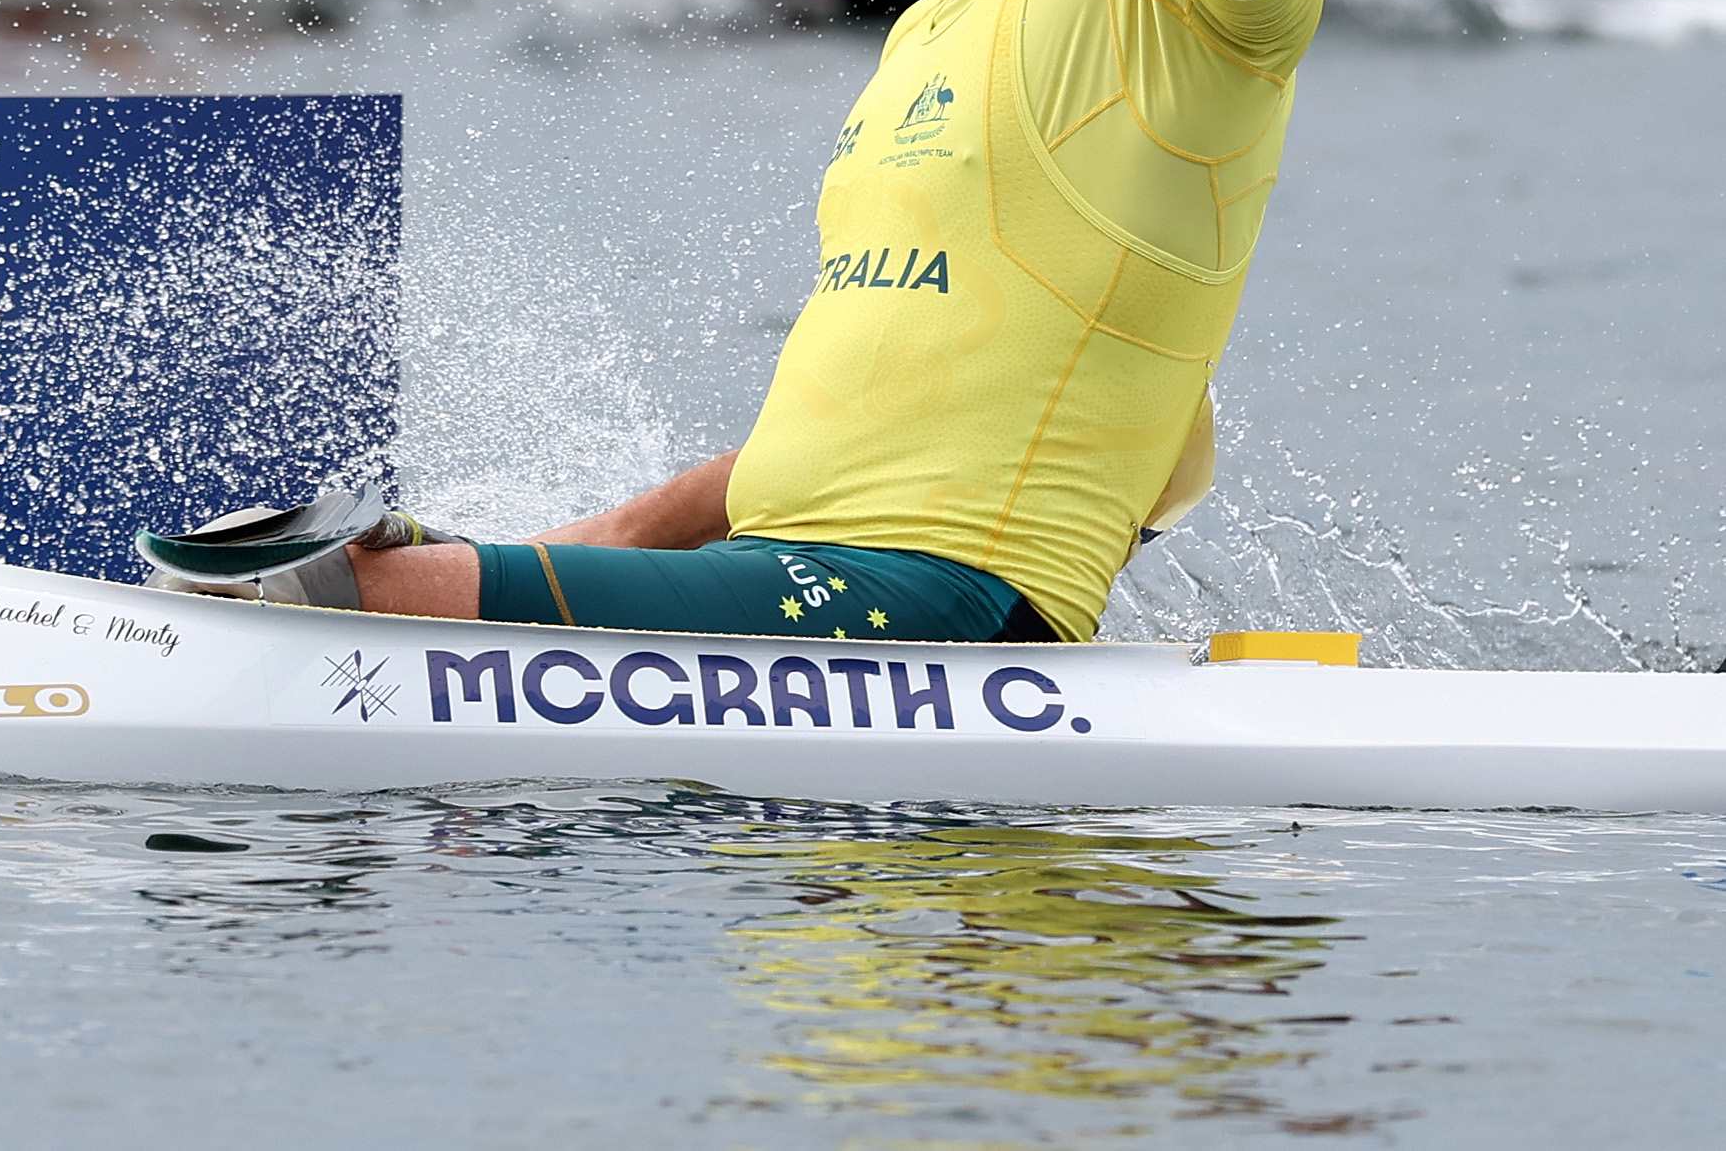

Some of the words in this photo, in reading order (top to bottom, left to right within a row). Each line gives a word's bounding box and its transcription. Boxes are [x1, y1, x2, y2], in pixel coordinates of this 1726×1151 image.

[935, 149, 953, 157] TEAM
[72, 614, 95, 635] &
[105, 616, 181, 657] Monty
[426, 650, 956, 730] MCGRATH
[981, 665, 1092, 734] C.
